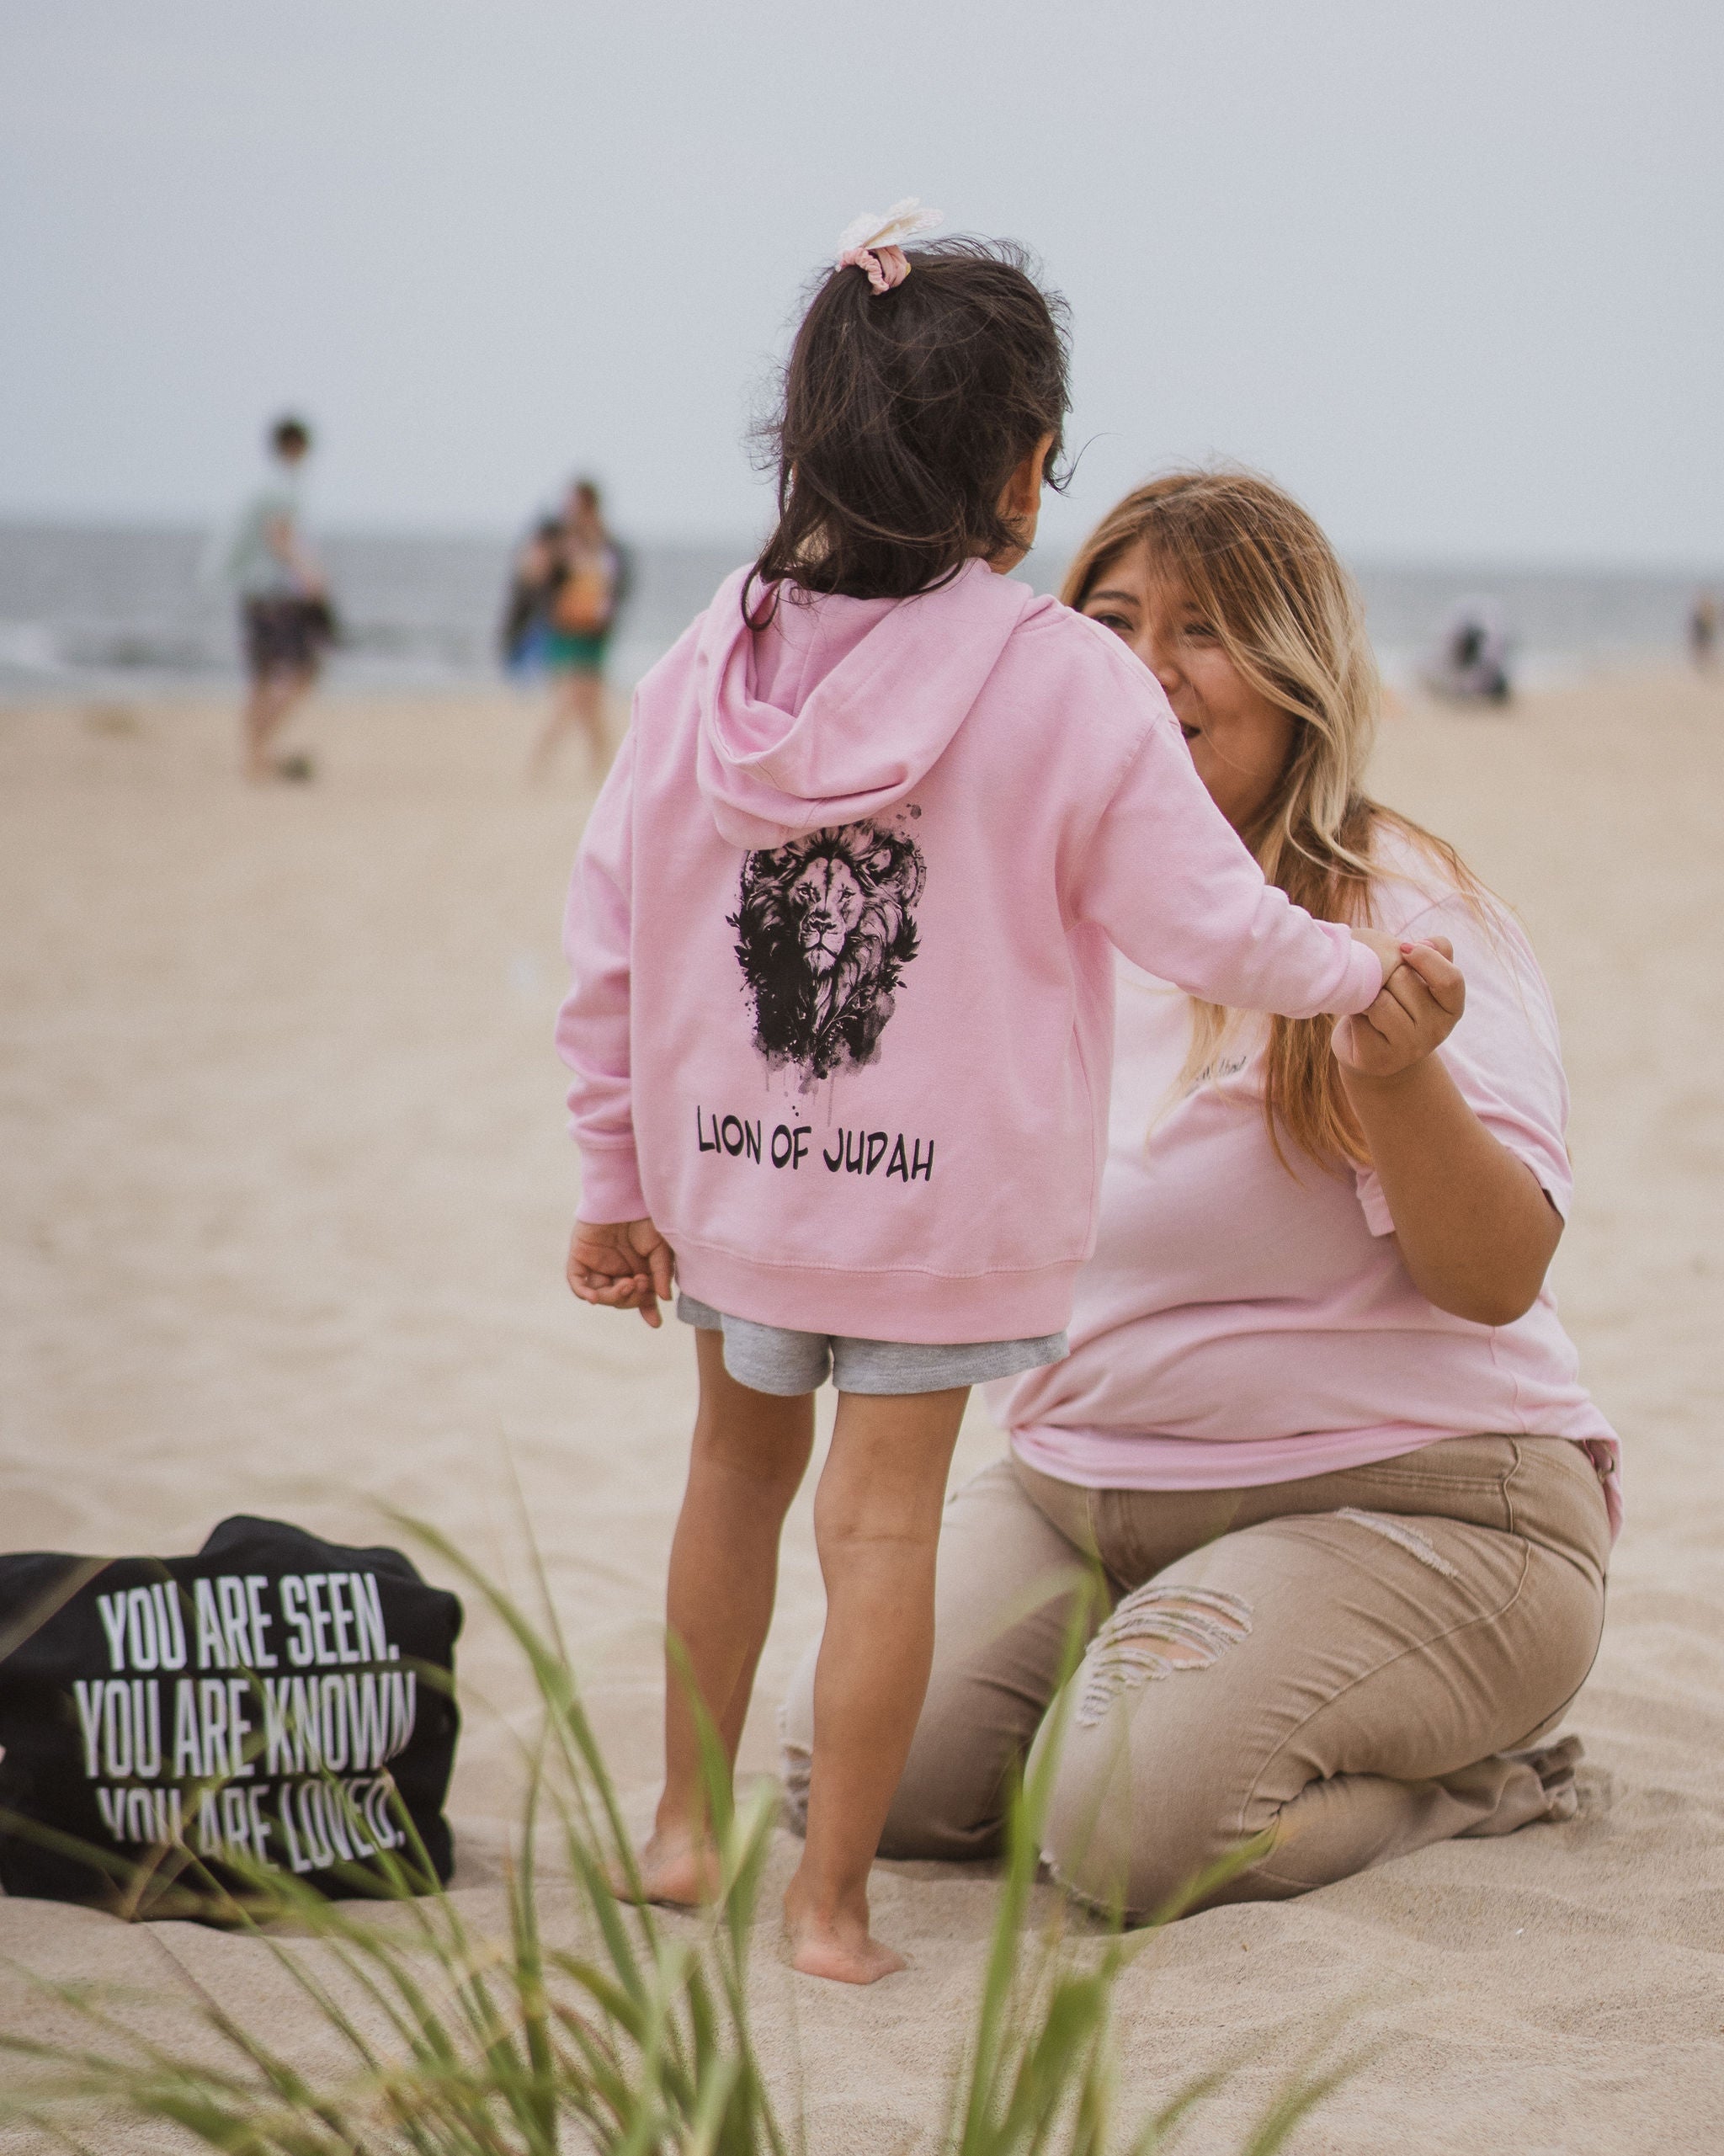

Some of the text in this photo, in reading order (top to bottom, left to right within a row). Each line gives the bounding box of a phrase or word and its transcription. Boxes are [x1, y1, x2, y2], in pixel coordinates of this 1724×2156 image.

[696, 1105, 935, 1183] LION OF JUDAH
[97, 1572, 401, 1672] YOU ARE SEEN.
[74, 1678, 162, 1779] YOU
[173, 1678, 254, 1778] ARE
[198, 1783, 280, 1874] ARE
